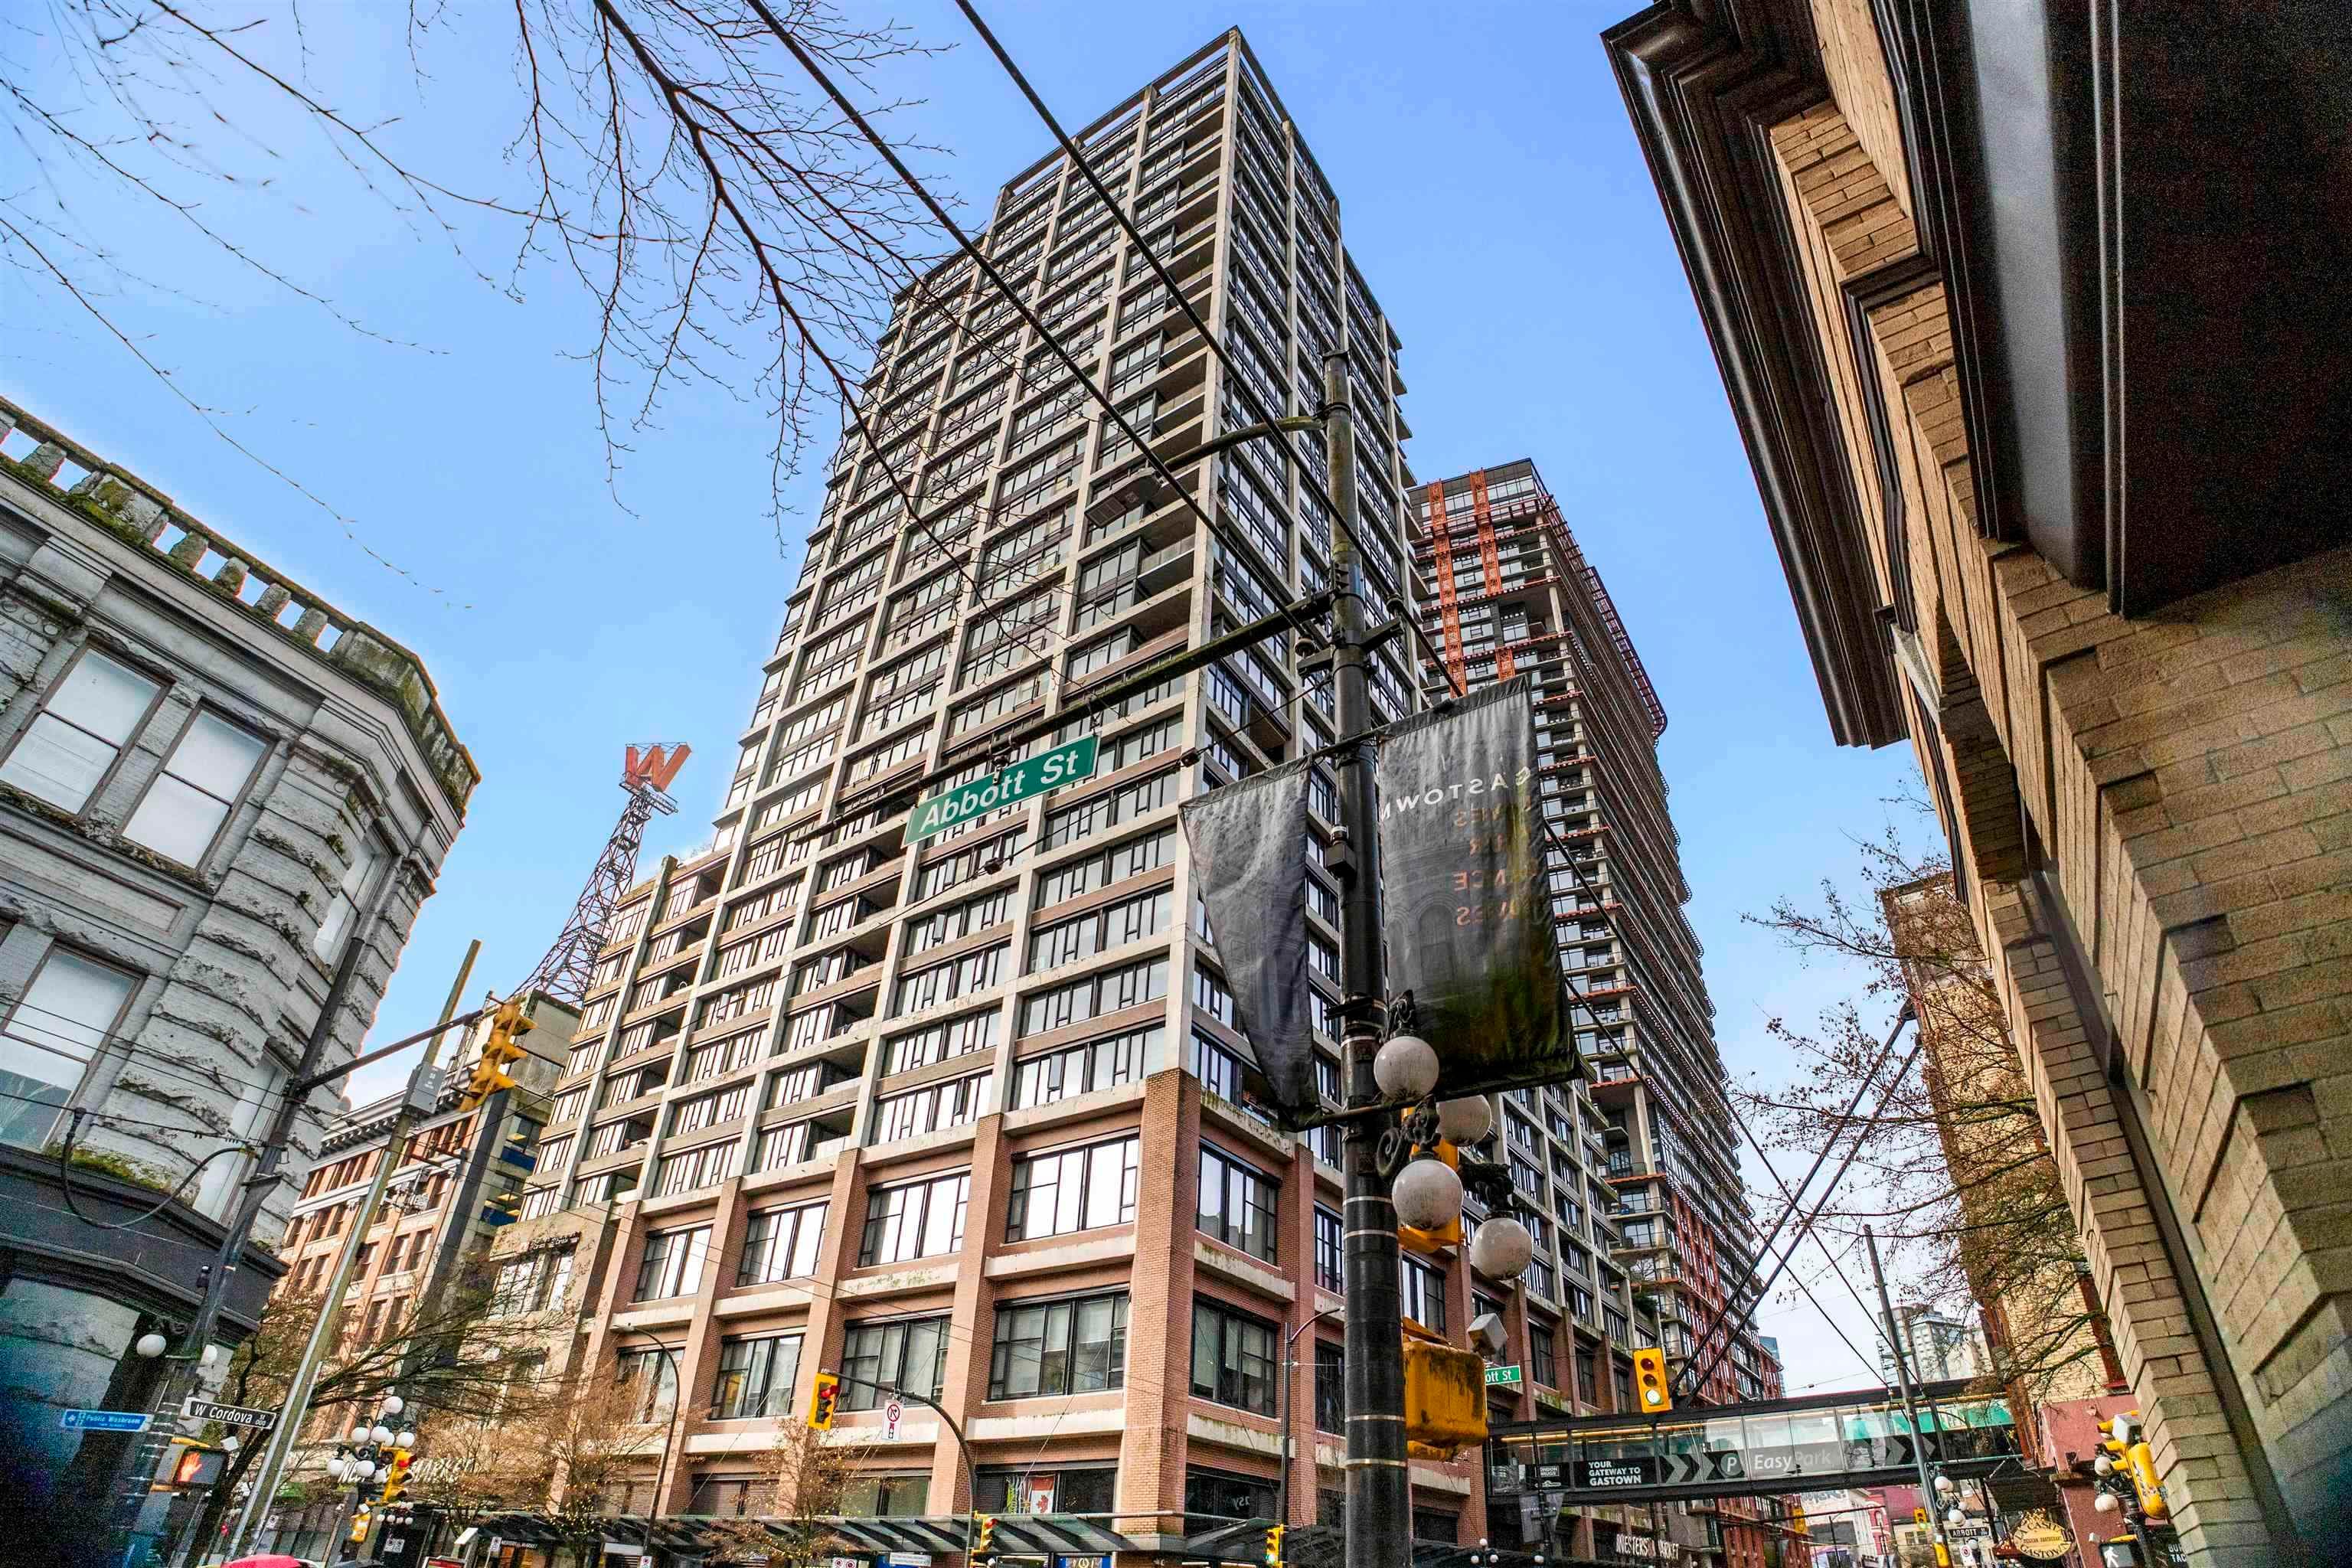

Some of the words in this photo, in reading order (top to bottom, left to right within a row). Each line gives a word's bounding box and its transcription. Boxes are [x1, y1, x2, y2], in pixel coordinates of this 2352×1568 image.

[623, 742, 693, 792] W
[919, 769, 1026, 833] Abbott
[1040, 750, 1079, 784] St
[1485, 1371, 1499, 1383] ott
[1501, 1370, 1513, 1380] St
[195, 1403, 207, 1416] W
[209, 1406, 253, 1424] Cordova
[1588, 1461, 1612, 1469] YOUR
[1726, 1457, 1737, 1472] P
[1589, 1468, 1627, 1477] GATEWAY
[1589, 1475, 1642, 1487] GASTOWN
[1952, 1528, 1977, 1537] ABBOTT
